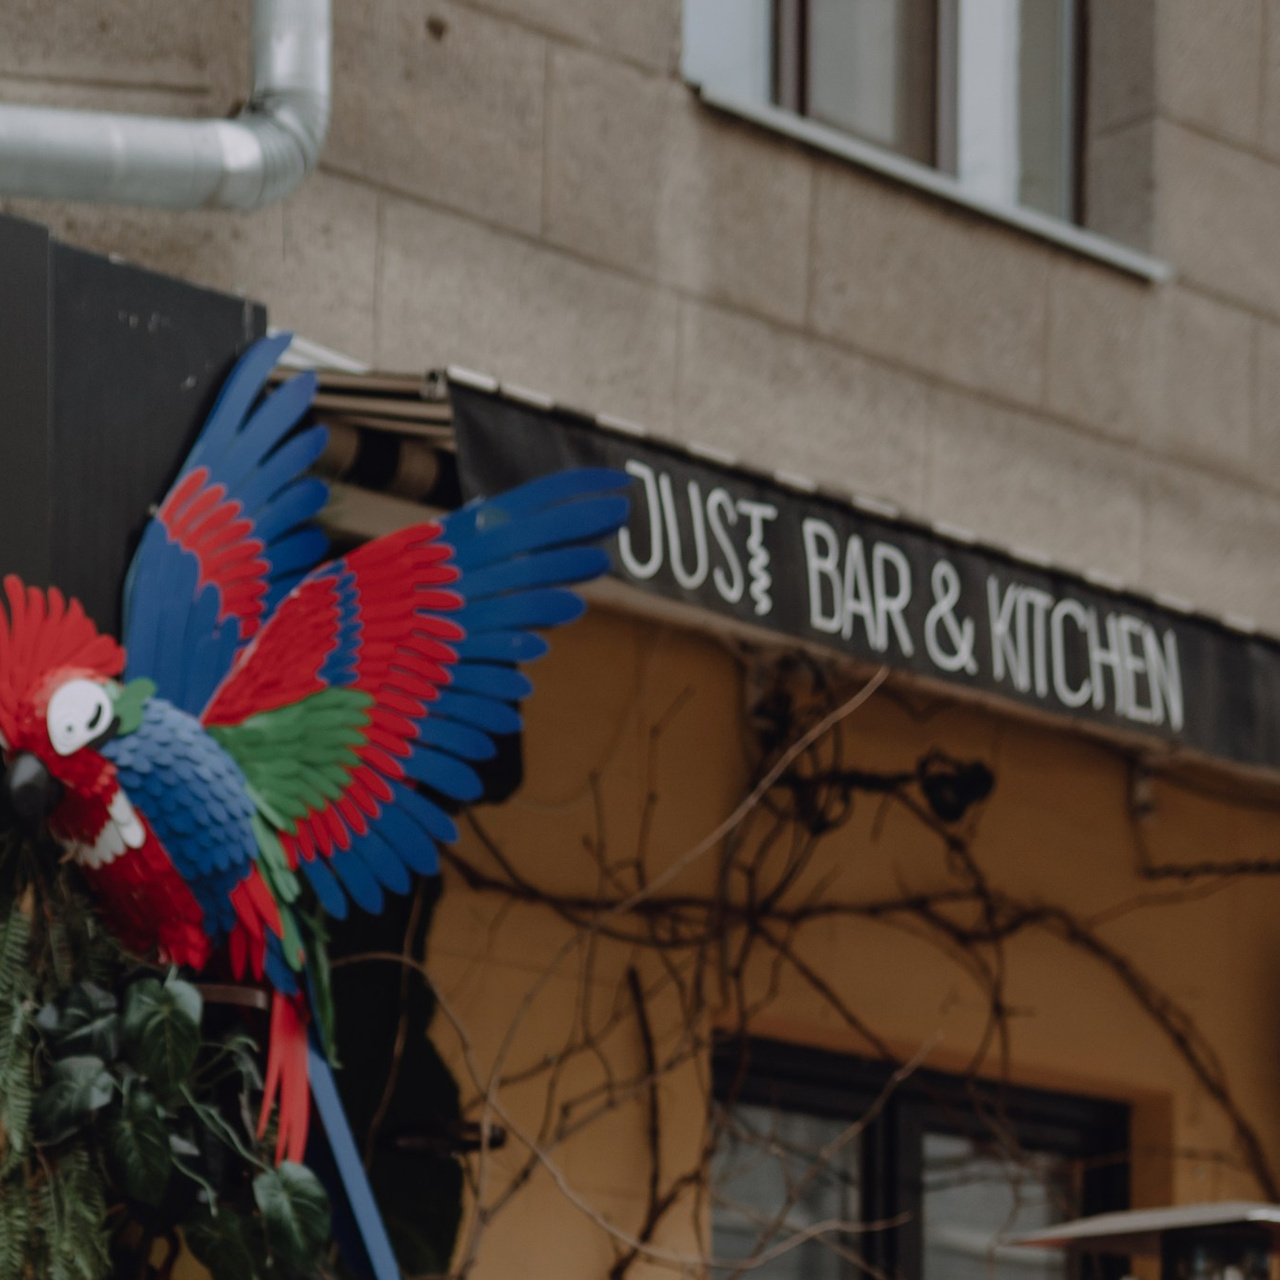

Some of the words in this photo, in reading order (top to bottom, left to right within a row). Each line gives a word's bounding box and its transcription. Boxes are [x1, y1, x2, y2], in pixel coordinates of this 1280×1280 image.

[618, 458, 778, 616] JUST
[802, 517, 914, 657] BAR
[924, 560, 978, 676] &
[987, 575, 1186, 732] KITCHEN
